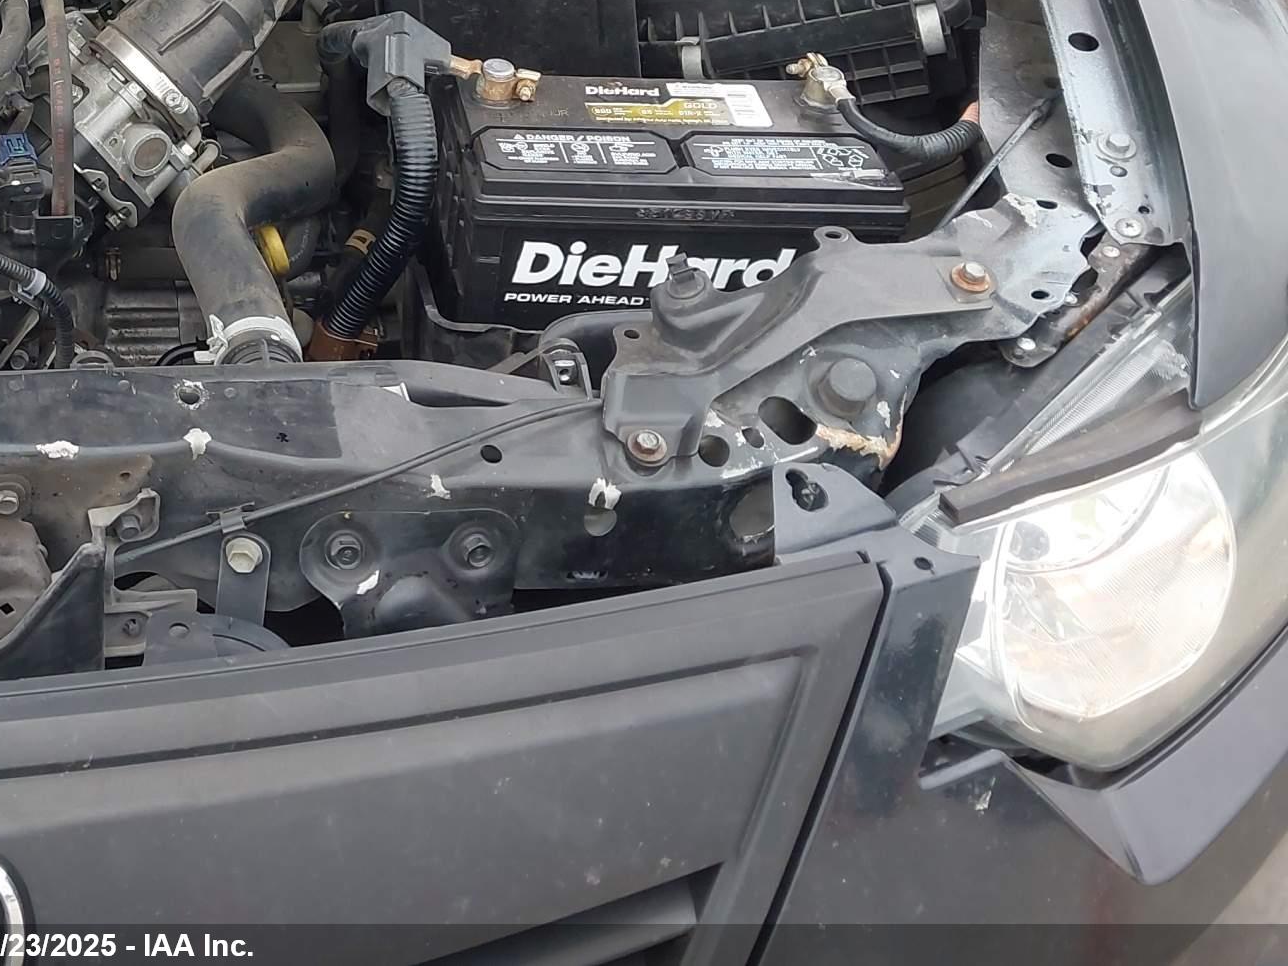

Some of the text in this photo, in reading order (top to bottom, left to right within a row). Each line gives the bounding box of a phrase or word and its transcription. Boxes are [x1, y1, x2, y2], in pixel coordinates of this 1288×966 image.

[585, 85, 660, 97] DieHard
[683, 101, 717, 109] GOLD
[504, 292, 646, 306] POWER AHEAD
